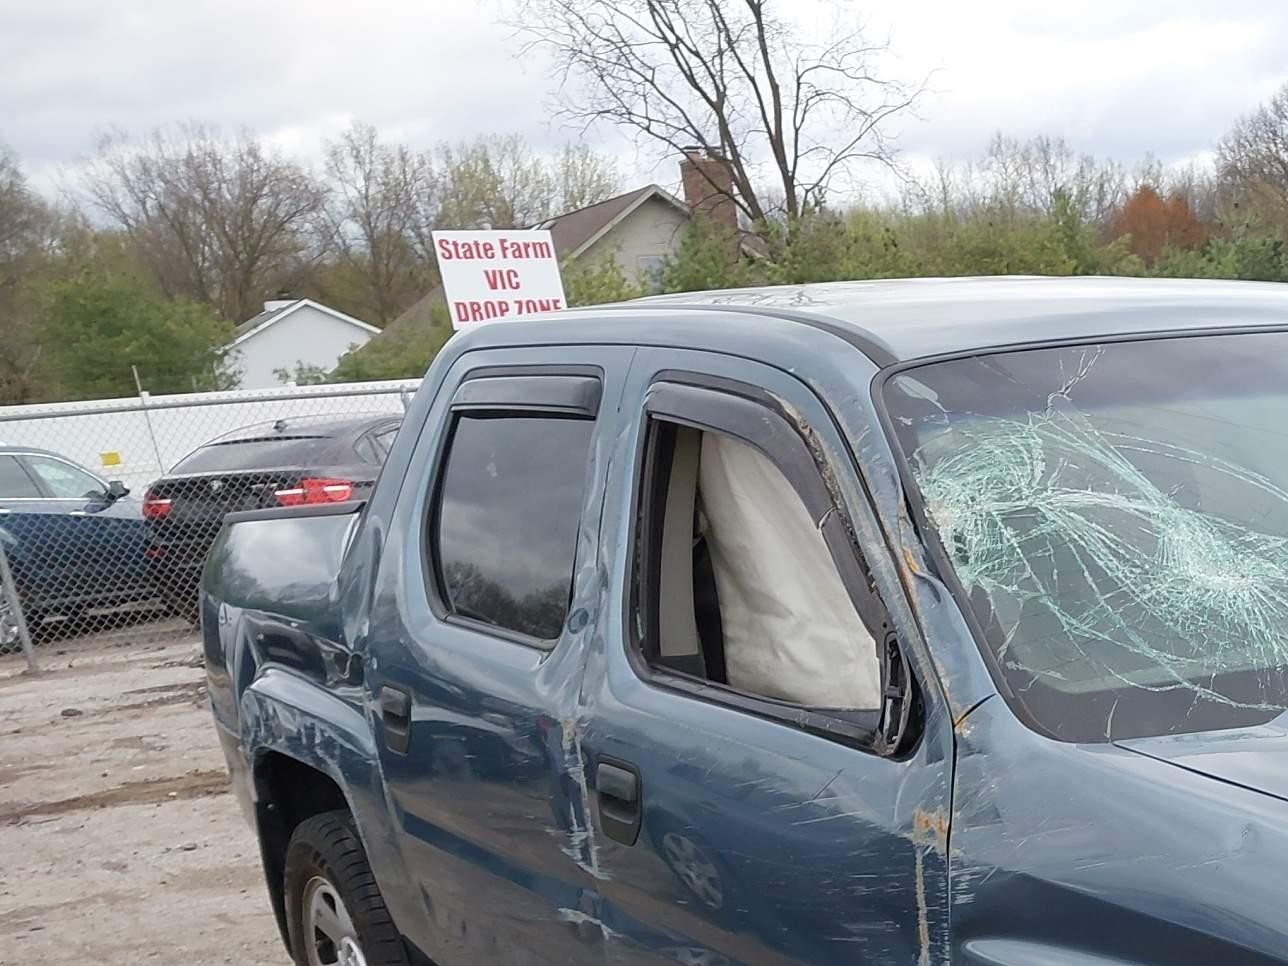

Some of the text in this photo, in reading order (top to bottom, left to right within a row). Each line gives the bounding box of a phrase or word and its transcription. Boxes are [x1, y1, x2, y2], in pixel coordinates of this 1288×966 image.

[438, 238, 553, 260] State Farm
[483, 269, 521, 290] VIC
[454, 300, 510, 322] DROP
